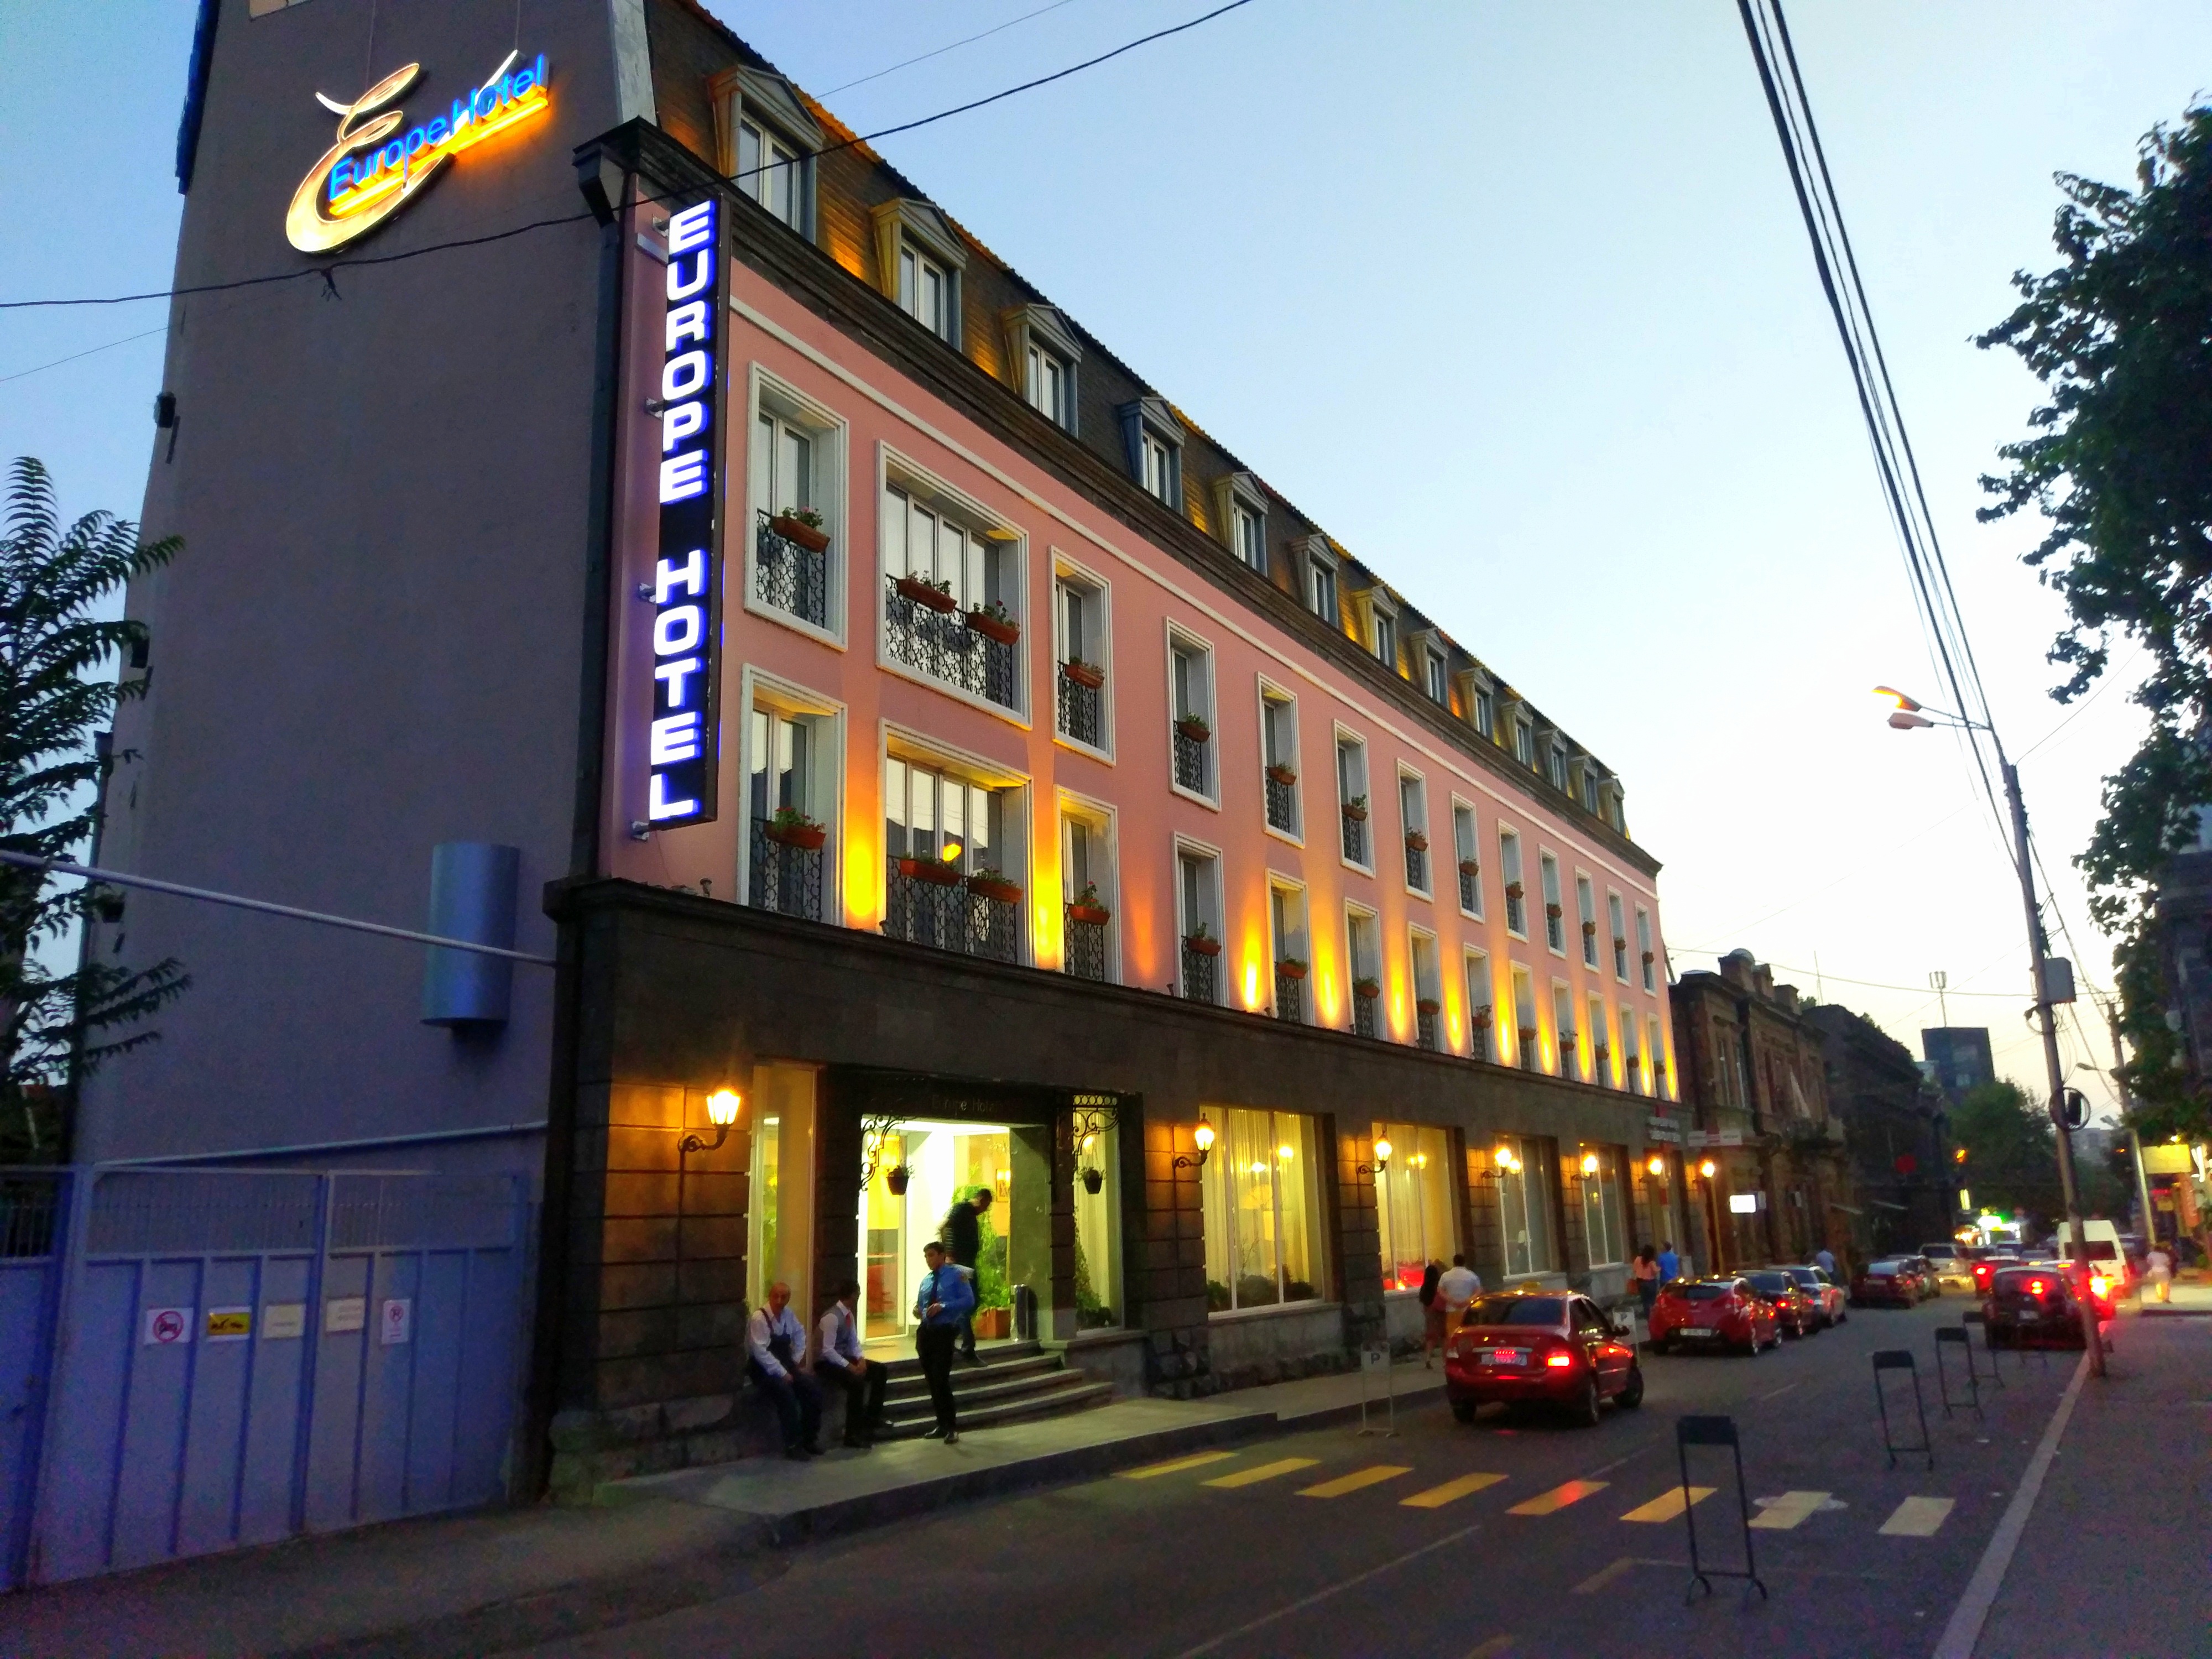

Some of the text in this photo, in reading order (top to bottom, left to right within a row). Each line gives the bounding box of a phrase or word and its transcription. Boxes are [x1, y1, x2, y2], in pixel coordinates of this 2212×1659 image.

[329, 54, 546, 201] Europe Hotel
[649, 200, 715, 821] EUROPE HOTEL
[932, 1094, 968, 1116] Erpe
[1371, 1353, 1381, 1364] P
